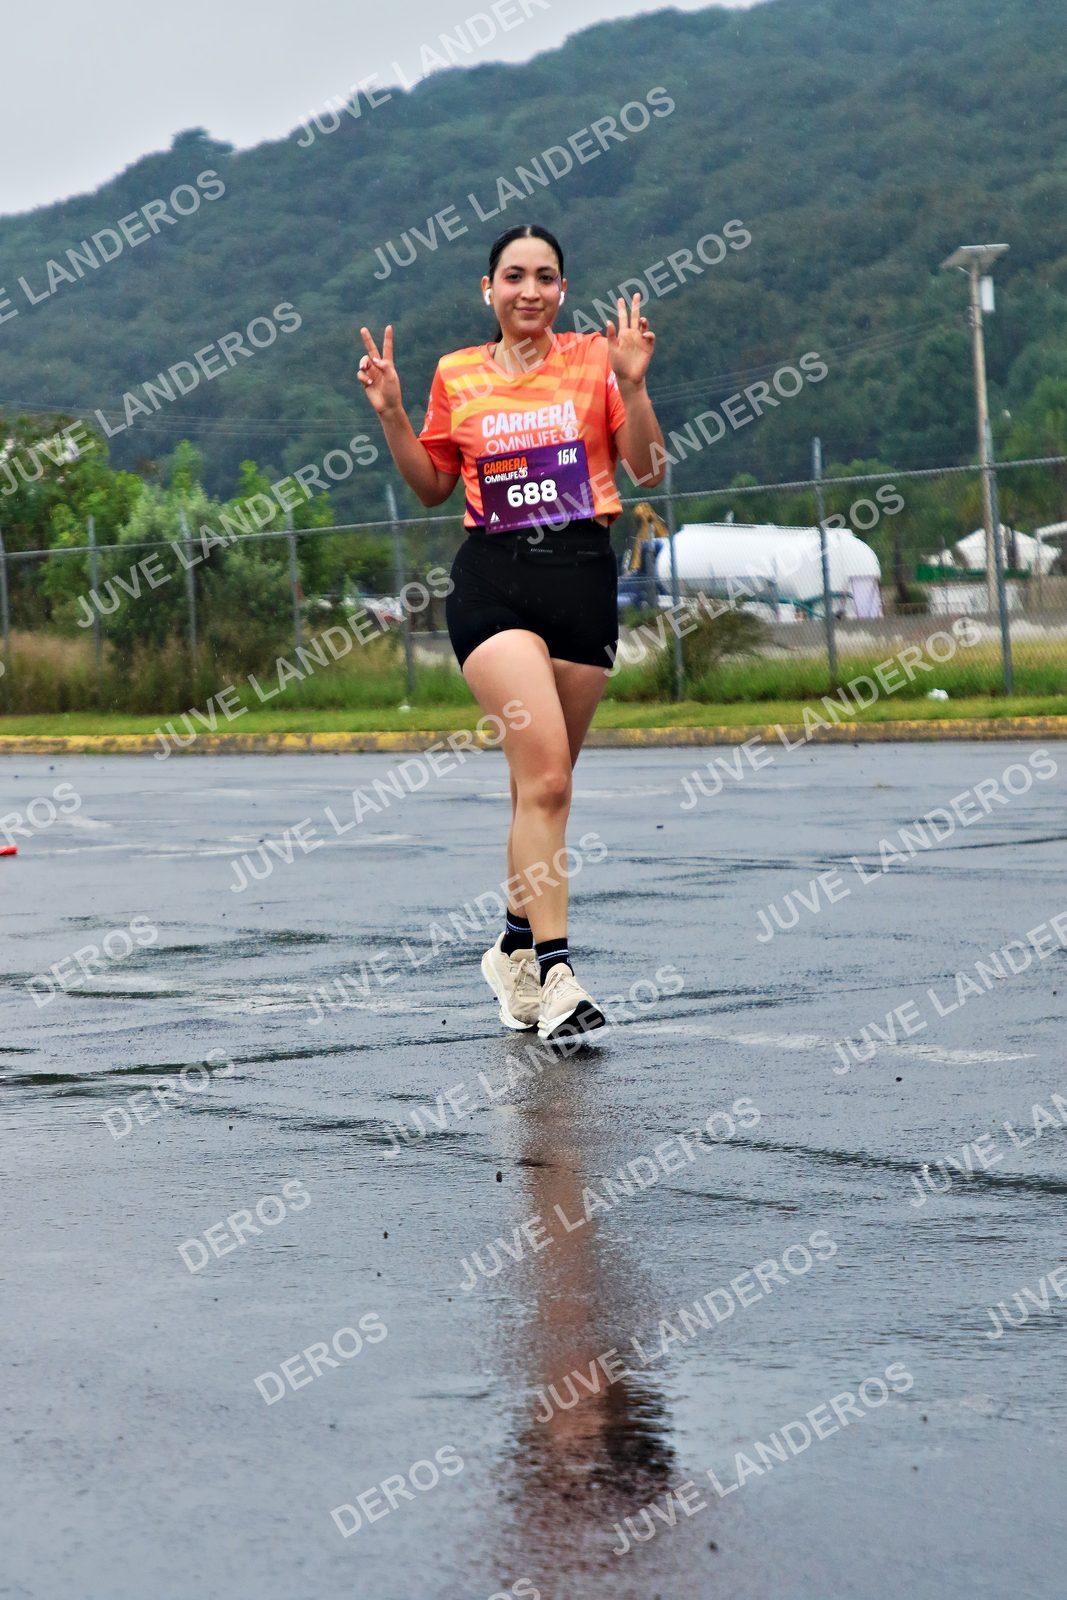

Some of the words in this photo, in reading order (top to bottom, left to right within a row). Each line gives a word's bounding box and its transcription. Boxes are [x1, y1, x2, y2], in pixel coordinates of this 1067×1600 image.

[482, 399, 577, 438] CARRERA
[486, 430, 559, 454] OMNILIFE
[483, 457, 528, 475] CARRERA
[485, 471, 518, 484] OMNILIFE
[507, 479, 558, 507] 688
